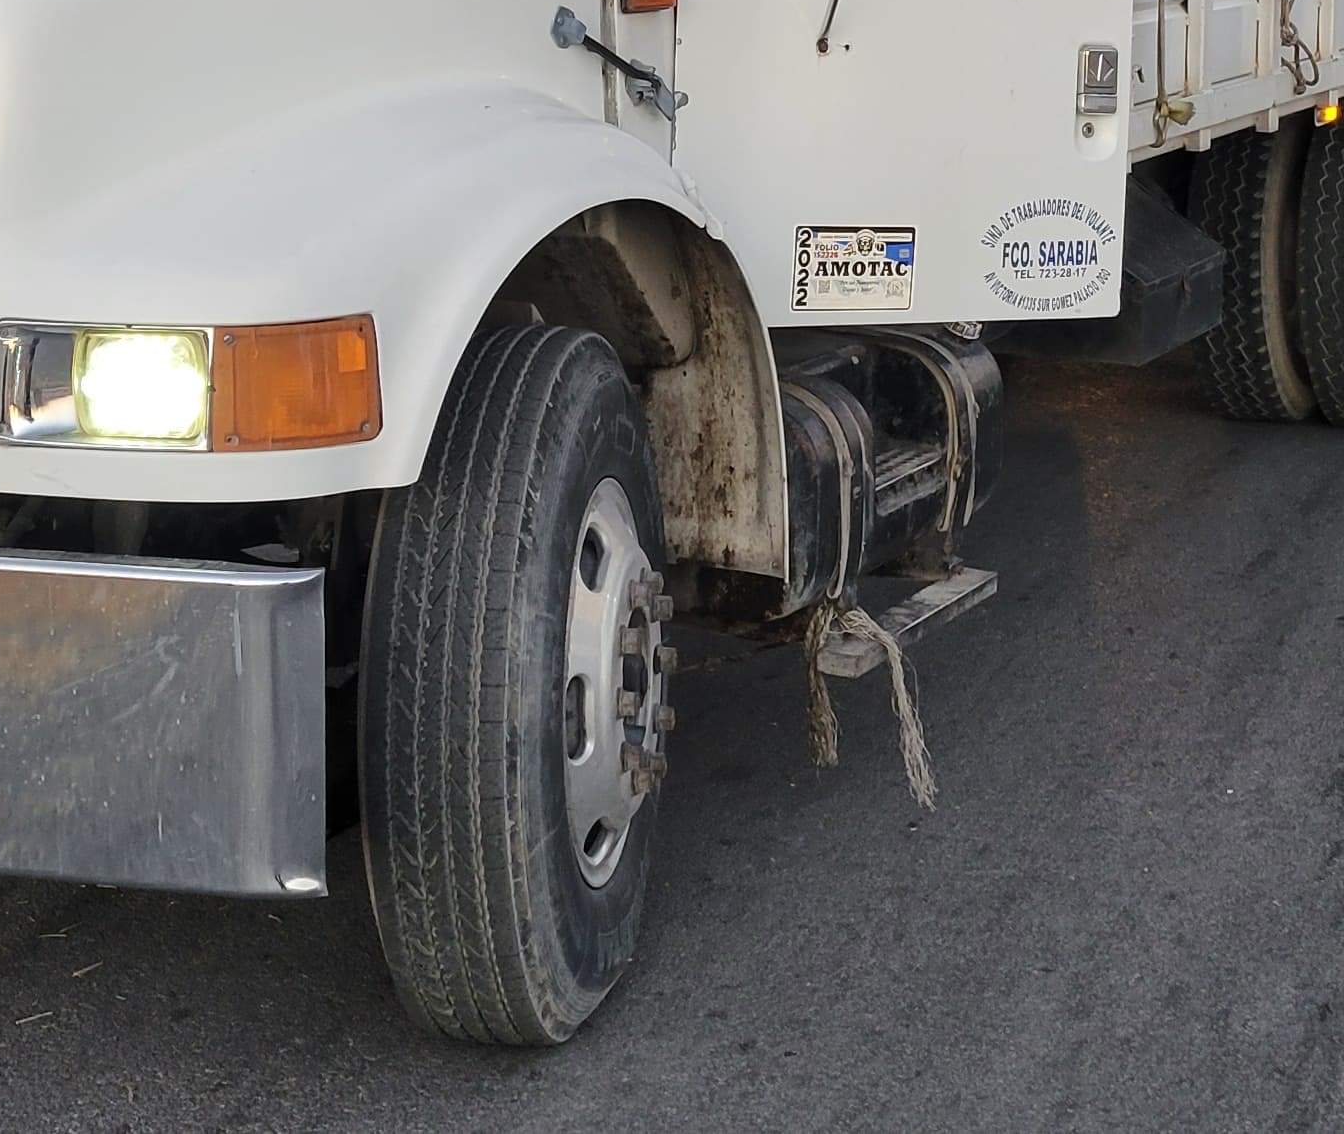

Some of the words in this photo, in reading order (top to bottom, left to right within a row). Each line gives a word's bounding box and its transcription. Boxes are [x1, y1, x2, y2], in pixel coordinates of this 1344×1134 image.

[1000, 212, 1015, 230] DE
[1011, 199, 1071, 224] TRABAJADORES
[1071, 202, 1086, 220] DEL
[1085, 208, 1116, 245] VOLANTE
[795, 229, 812, 307] 2022
[814, 261, 908, 277] AMOTAC
[1002, 242, 1033, 268] FCO.
[1039, 240, 1098, 267] SARABIA
[1014, 270, 1035, 279] TEL.
[1040, 268, 1087, 279] 723-28-17
[990, 279, 1017, 306] VICTORIA
[1037, 298, 1050, 312] SUR
[1052, 294, 1074, 311] GOMEZ
